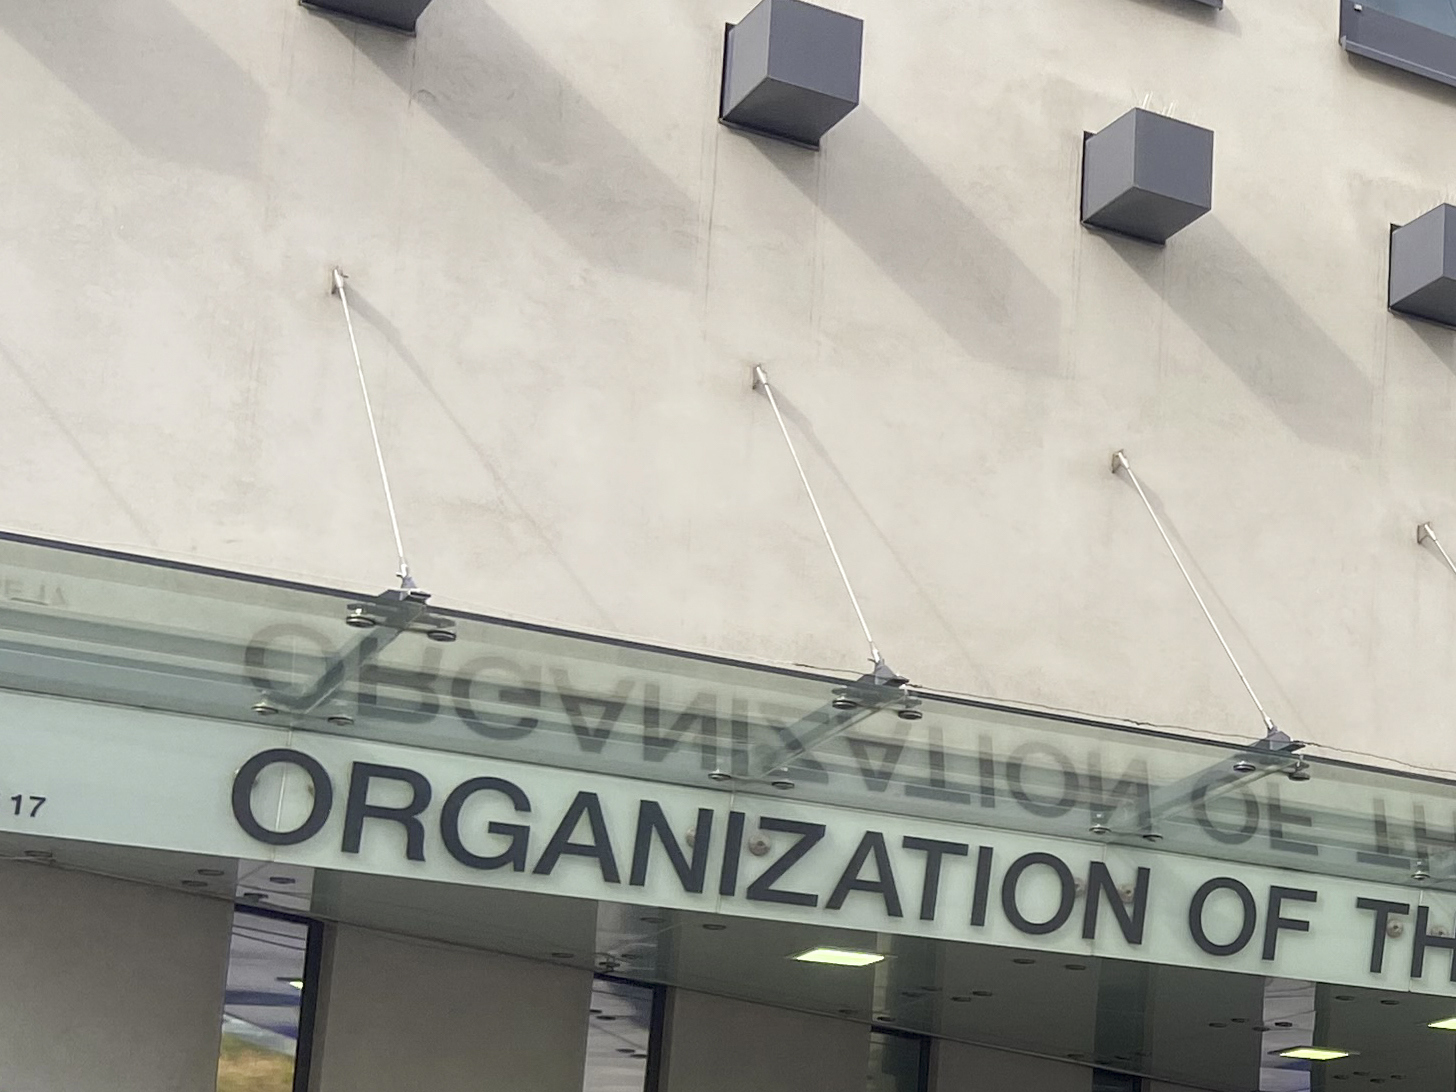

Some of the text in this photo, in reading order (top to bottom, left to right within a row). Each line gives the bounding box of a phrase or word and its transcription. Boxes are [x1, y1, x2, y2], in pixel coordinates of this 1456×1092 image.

[11, 794, 46, 818] 17
[231, 748, 1150, 946] ORGANIZATION
[1189, 877, 1318, 961] OF
